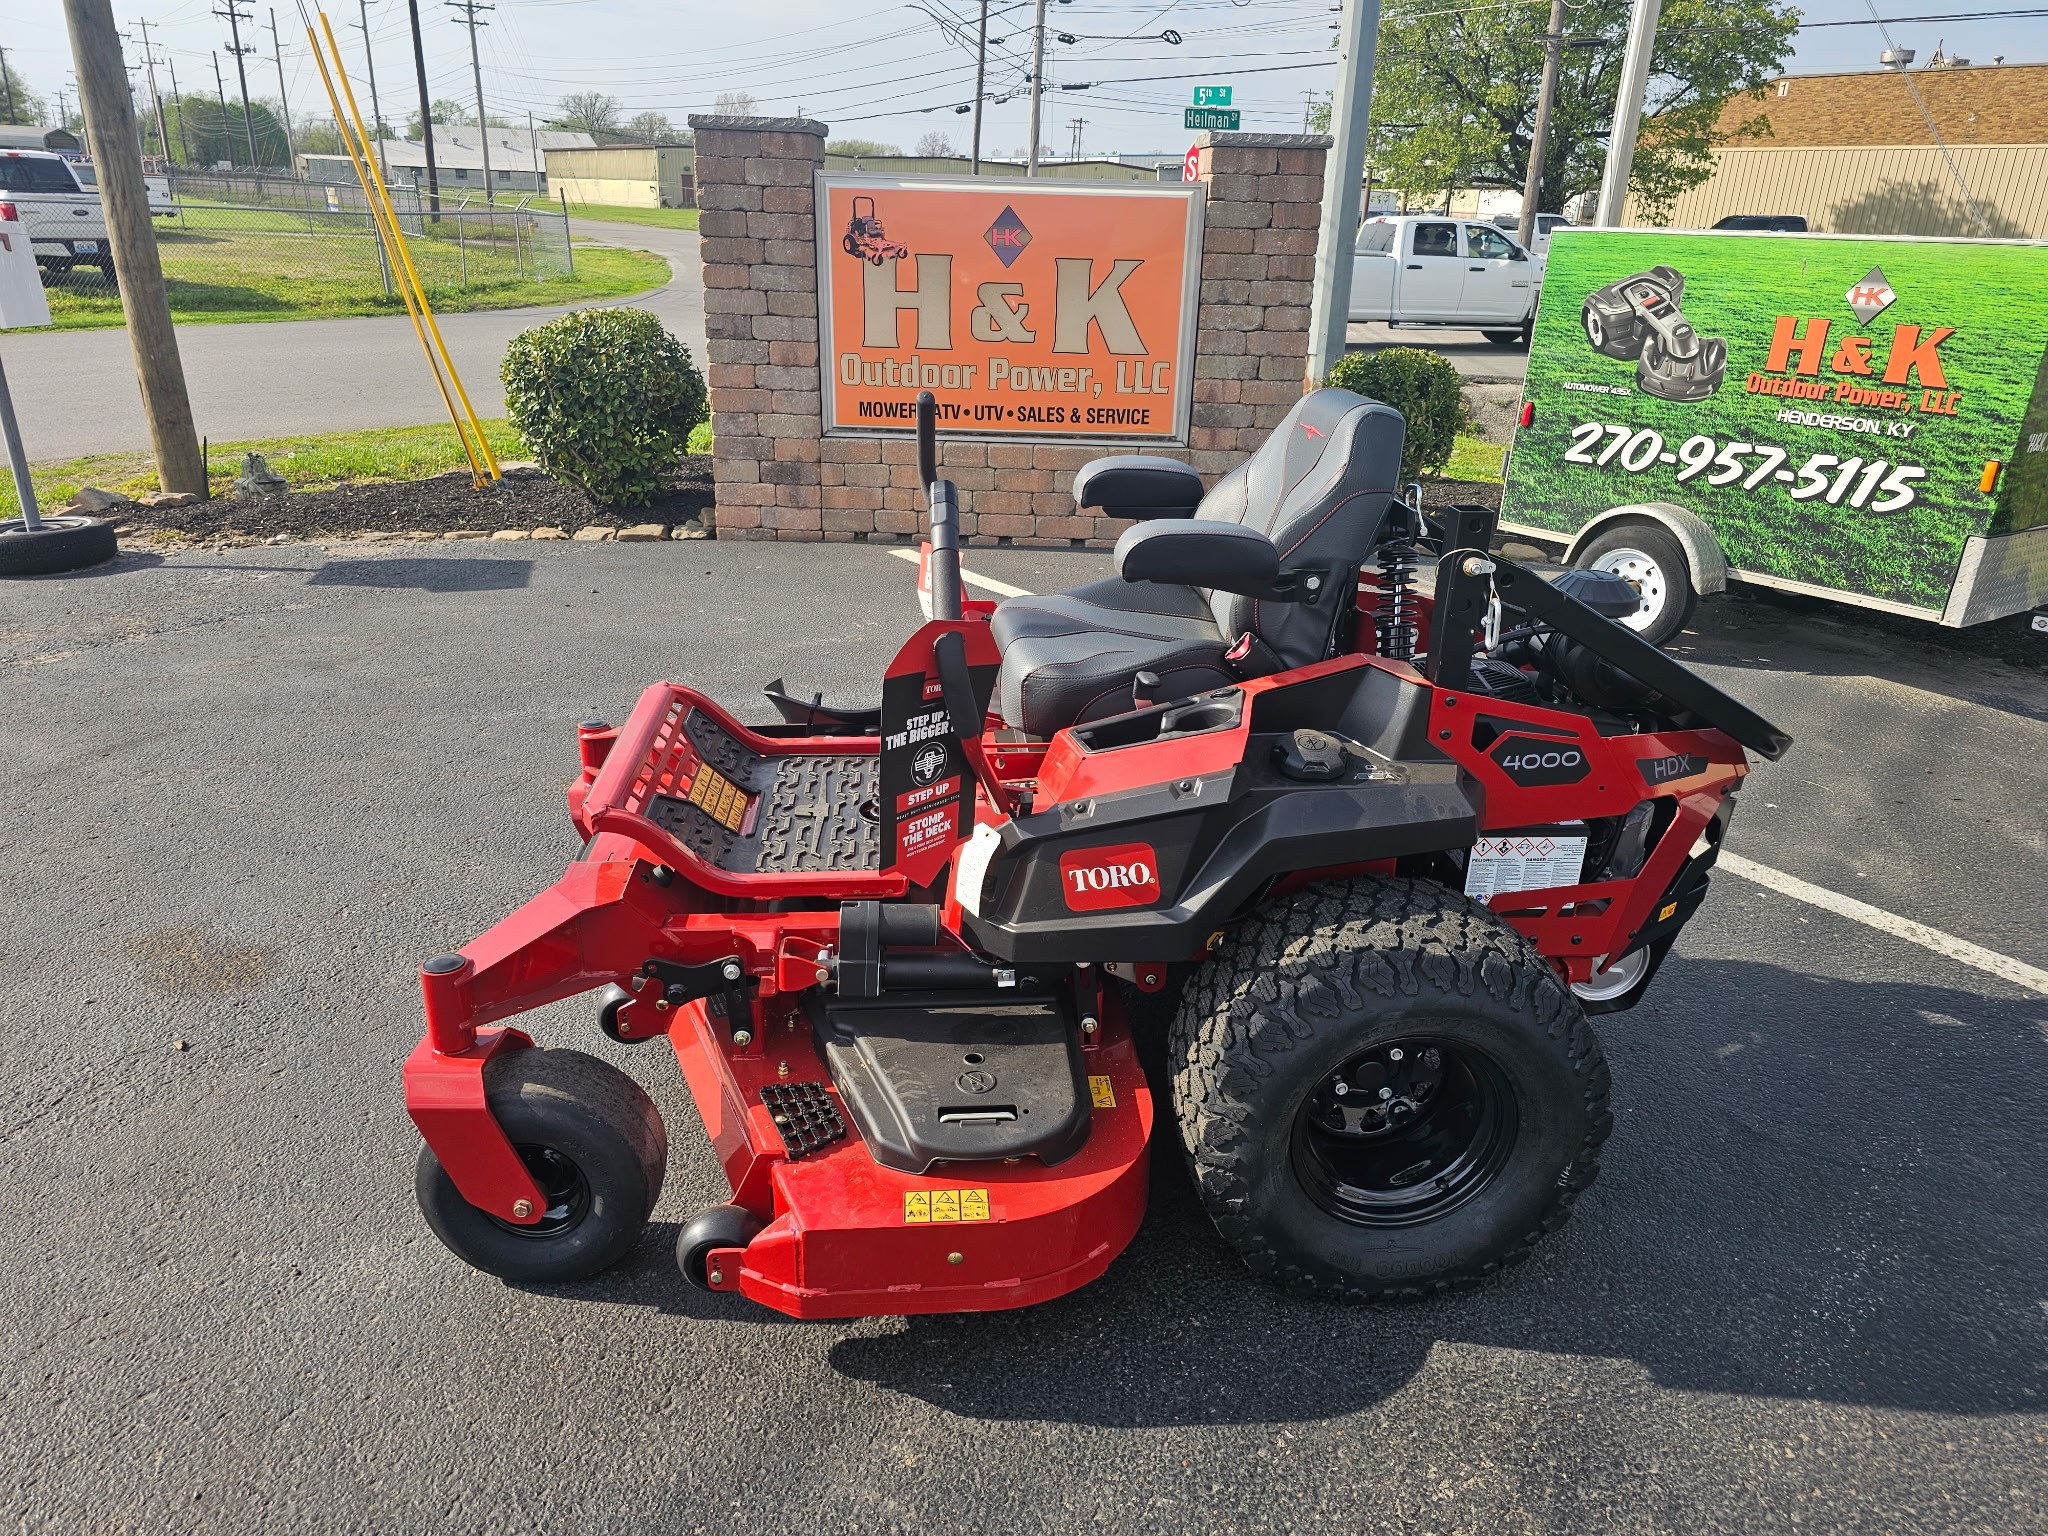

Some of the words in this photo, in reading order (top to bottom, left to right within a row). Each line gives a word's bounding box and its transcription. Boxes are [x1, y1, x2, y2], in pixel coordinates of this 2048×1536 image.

[1199, 87, 1212, 106] 5th
[1219, 88, 1226, 98] St
[1186, 110, 1229, 128] Heilman
[991, 228, 1023, 248] HK
[862, 253, 953, 350] H
[971, 282, 1036, 343] &
[1052, 258, 1149, 355] K
[1851, 286, 1889, 306] HK
[1764, 315, 1832, 376] H
[1831, 336, 1873, 375] &
[1882, 324, 1956, 388] K
[840, 352, 977, 389] Outdoor
[988, 357, 1102, 399] Power,
[1115, 361, 1171, 394] LLC
[1746, 372, 1830, 400] Outdoor
[1834, 382, 1912, 414] Power,
[1920, 390, 1962, 415] LLC
[859, 401, 917, 418] MOWER
[934, 404, 961, 420] ATV
[974, 405, 1004, 421] UTV
[1017, 406, 1064, 423] SALES
[1070, 408, 1081, 423] &
[1086, 408, 1150, 425] SERVICE
[1776, 409, 1881, 435] HENDERSON,
[1886, 422, 1916, 438] KY
[1564, 421, 1927, 513] 270-957-5115
[925, 684, 943, 694] TOR
[906, 713, 930, 730] STEP
[931, 710, 945, 724] UP
[885, 731, 907, 750] THE
[908, 721, 949, 744] BIGGER
[1502, 751, 1581, 770] 4000
[1654, 754, 1691, 779] HDX
[908, 787, 934, 806] STEP
[935, 782, 950, 795] UP
[902, 830, 923, 847] THE
[925, 819, 952, 839] DECK
[908, 811, 945, 834] STOMP
[1068, 862, 1151, 892] TORO
